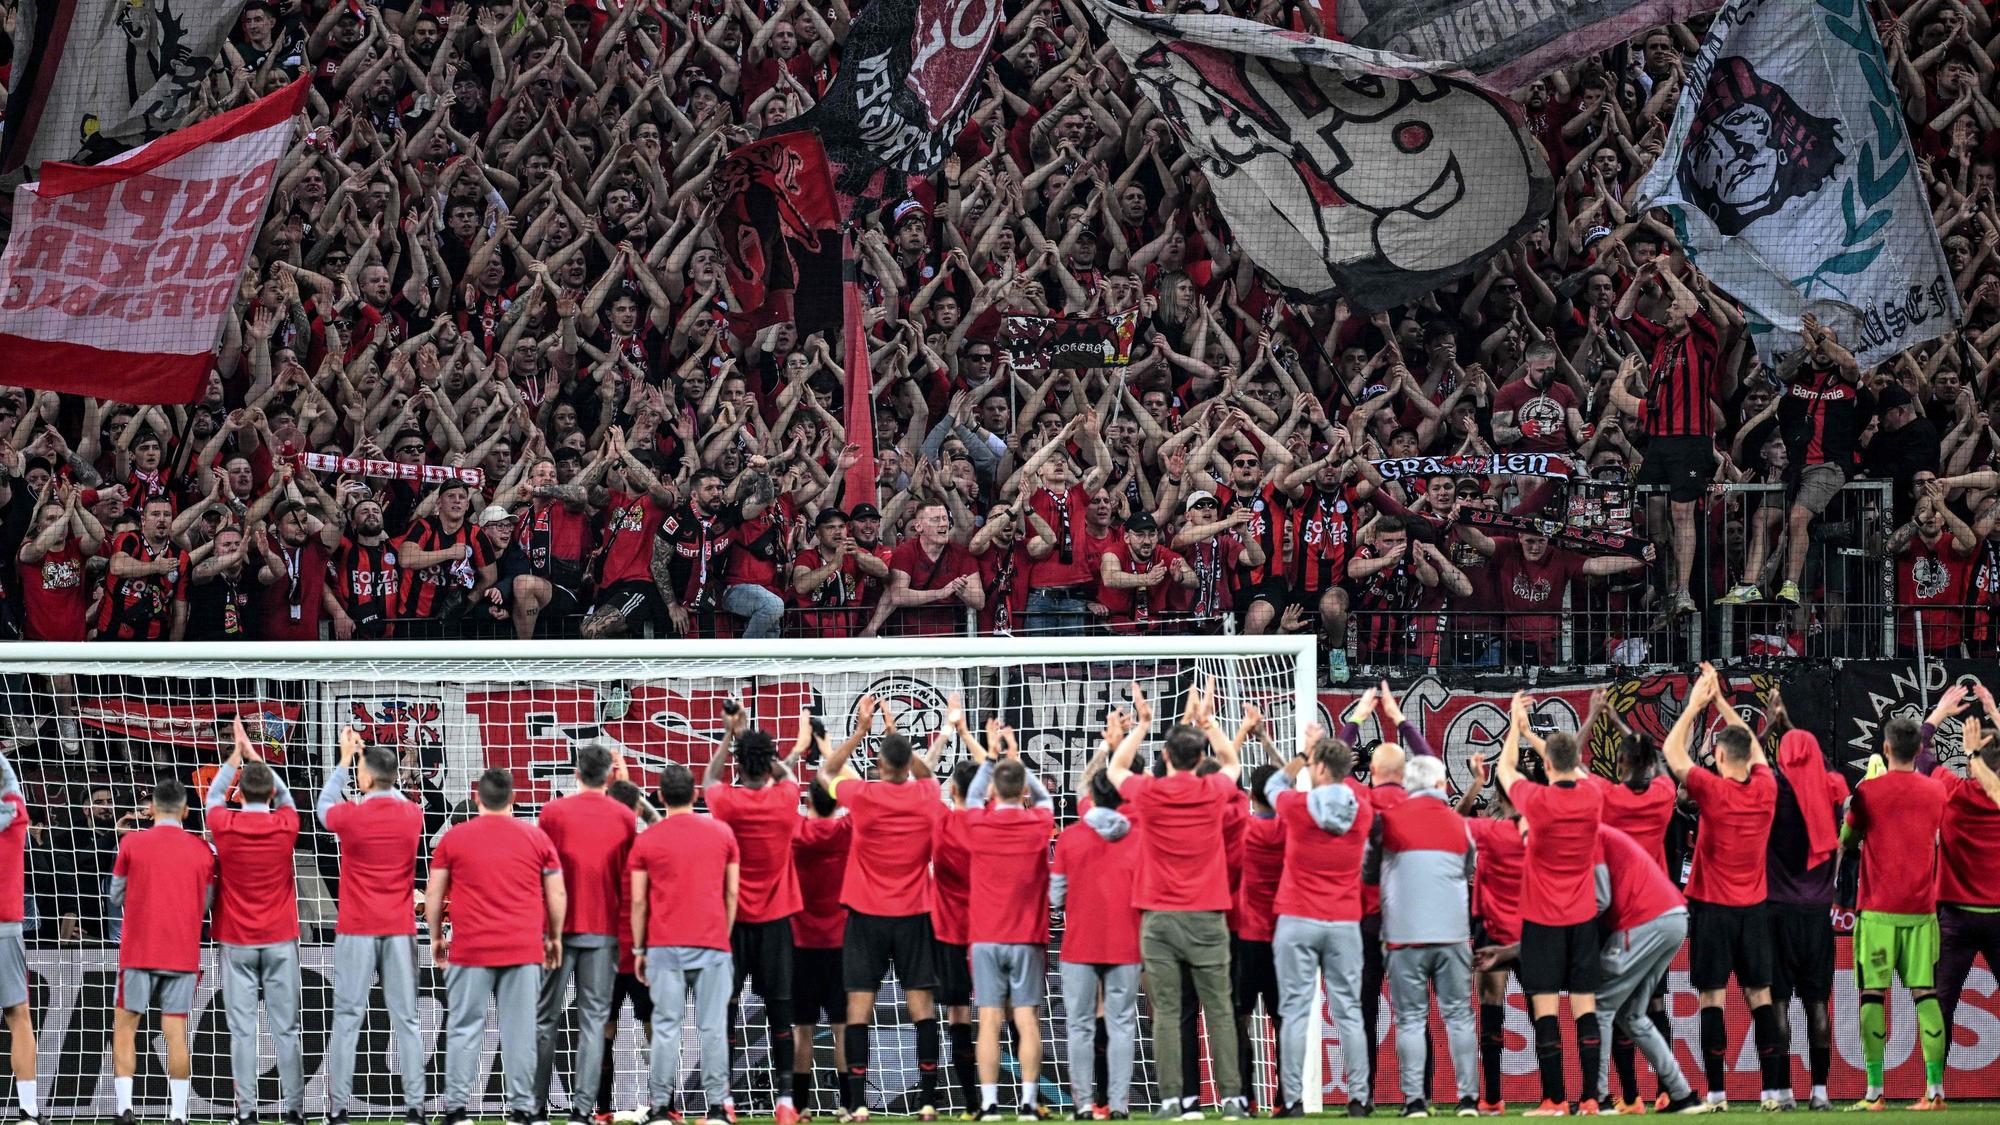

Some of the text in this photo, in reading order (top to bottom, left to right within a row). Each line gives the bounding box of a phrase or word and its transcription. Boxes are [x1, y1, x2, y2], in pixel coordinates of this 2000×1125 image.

[1053, 342, 1105, 355] JOKERS
[1303, 530, 1348, 546] BAER
[1028, 675, 1169, 734] WEST
